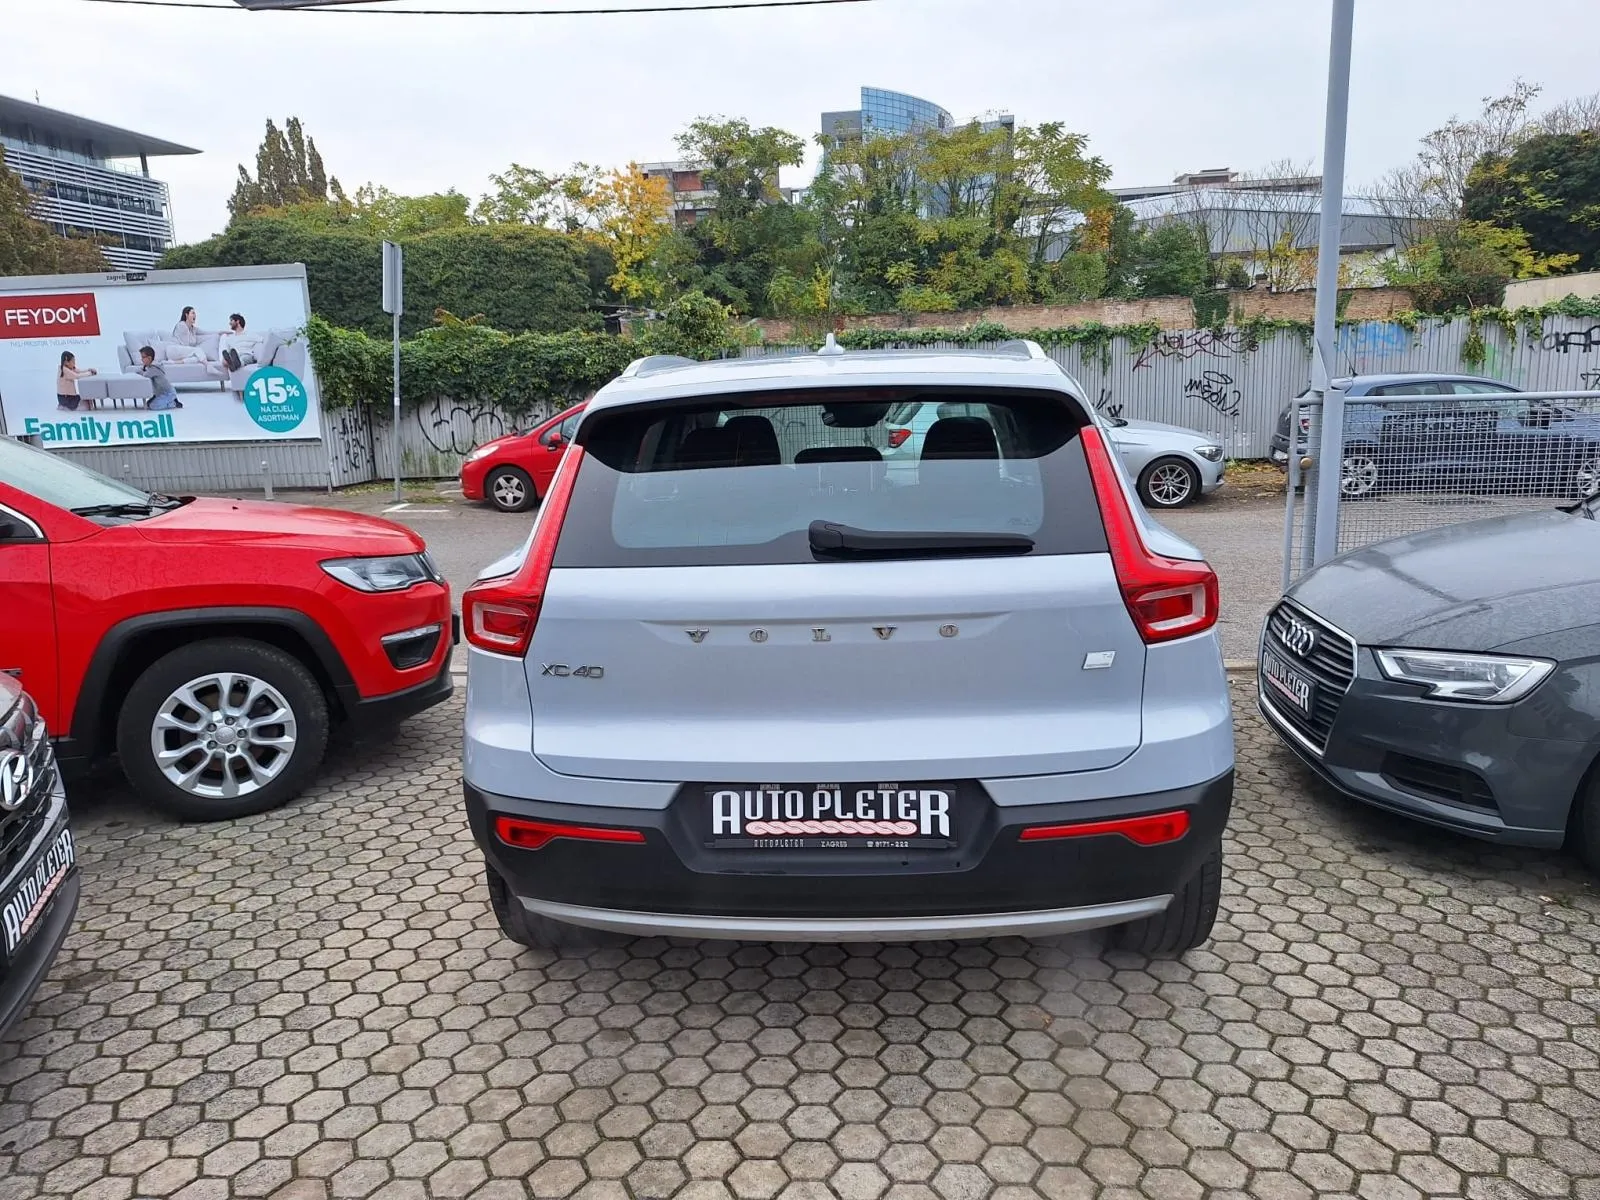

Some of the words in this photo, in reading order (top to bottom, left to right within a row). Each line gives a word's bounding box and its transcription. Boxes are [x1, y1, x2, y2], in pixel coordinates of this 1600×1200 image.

[4, 307, 86, 326] FEYDOM
[249, 377, 300, 404] -15%
[258, 414, 300, 422] ASORTIMAN
[260, 405, 271, 413] NA
[272, 404, 294, 413] CIJELI
[24, 416, 111, 443] Family
[117, 414, 175, 439] mall
[685, 622, 959, 643] VOLVO
[812, 790, 950, 837] PLETER
[820, 840, 848, 848] ZAGREB
